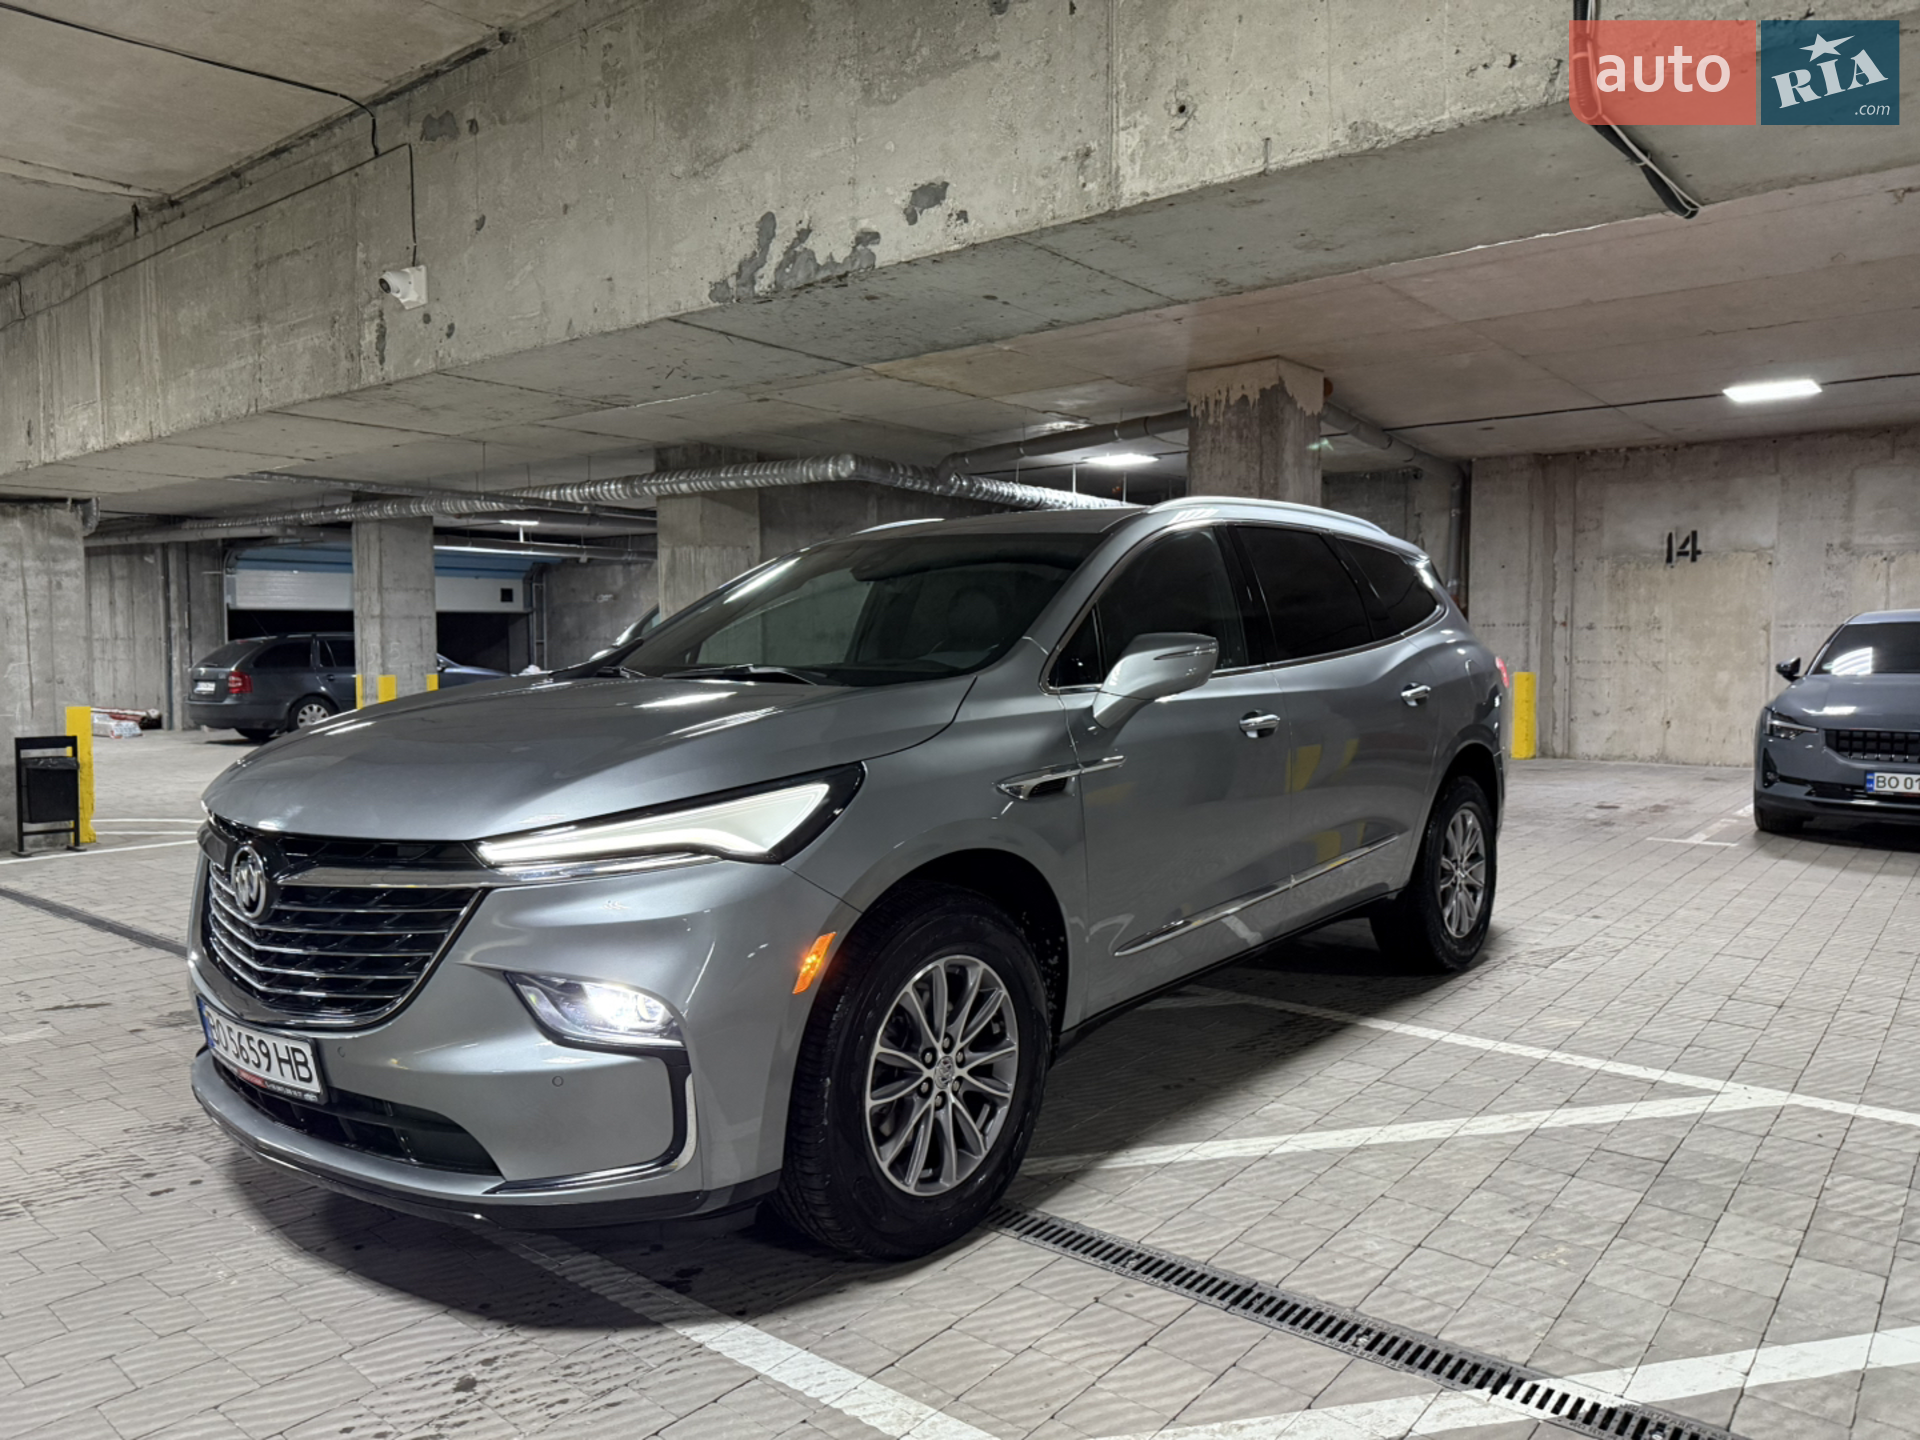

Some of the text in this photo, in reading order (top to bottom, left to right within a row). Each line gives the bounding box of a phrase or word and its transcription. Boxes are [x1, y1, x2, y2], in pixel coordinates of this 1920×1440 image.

[1665, 529, 1702, 564] 14
[1876, 775, 1900, 790] BO
[227, 1025, 272, 1073] 5659
[272, 1042, 313, 1083] HB
